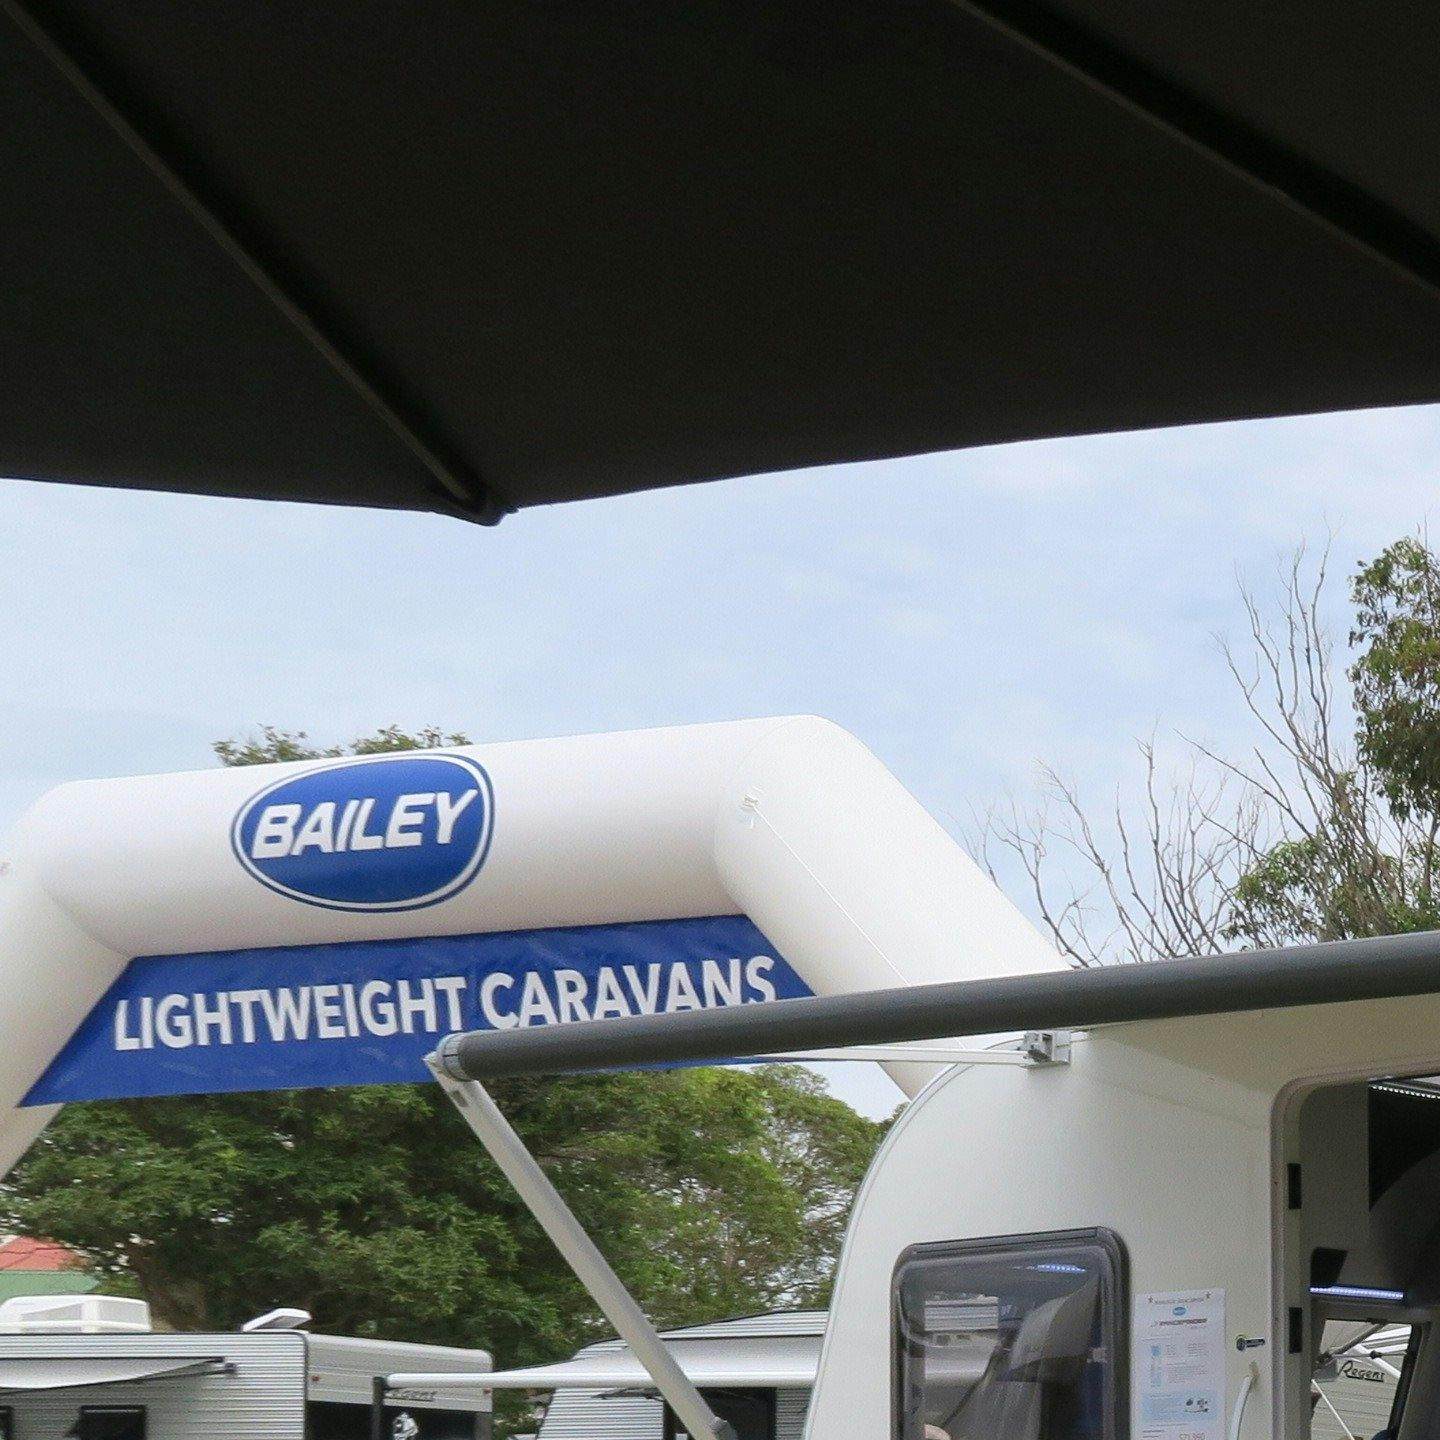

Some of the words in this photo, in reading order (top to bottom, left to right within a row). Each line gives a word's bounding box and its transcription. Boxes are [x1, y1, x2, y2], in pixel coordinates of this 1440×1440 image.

[252, 788, 478, 859] BAILEY
[113, 976, 466, 1051] LIGHTWEIGHT
[480, 955, 775, 1030] CARAVANS
[1337, 1360, 1386, 1382] Regent
